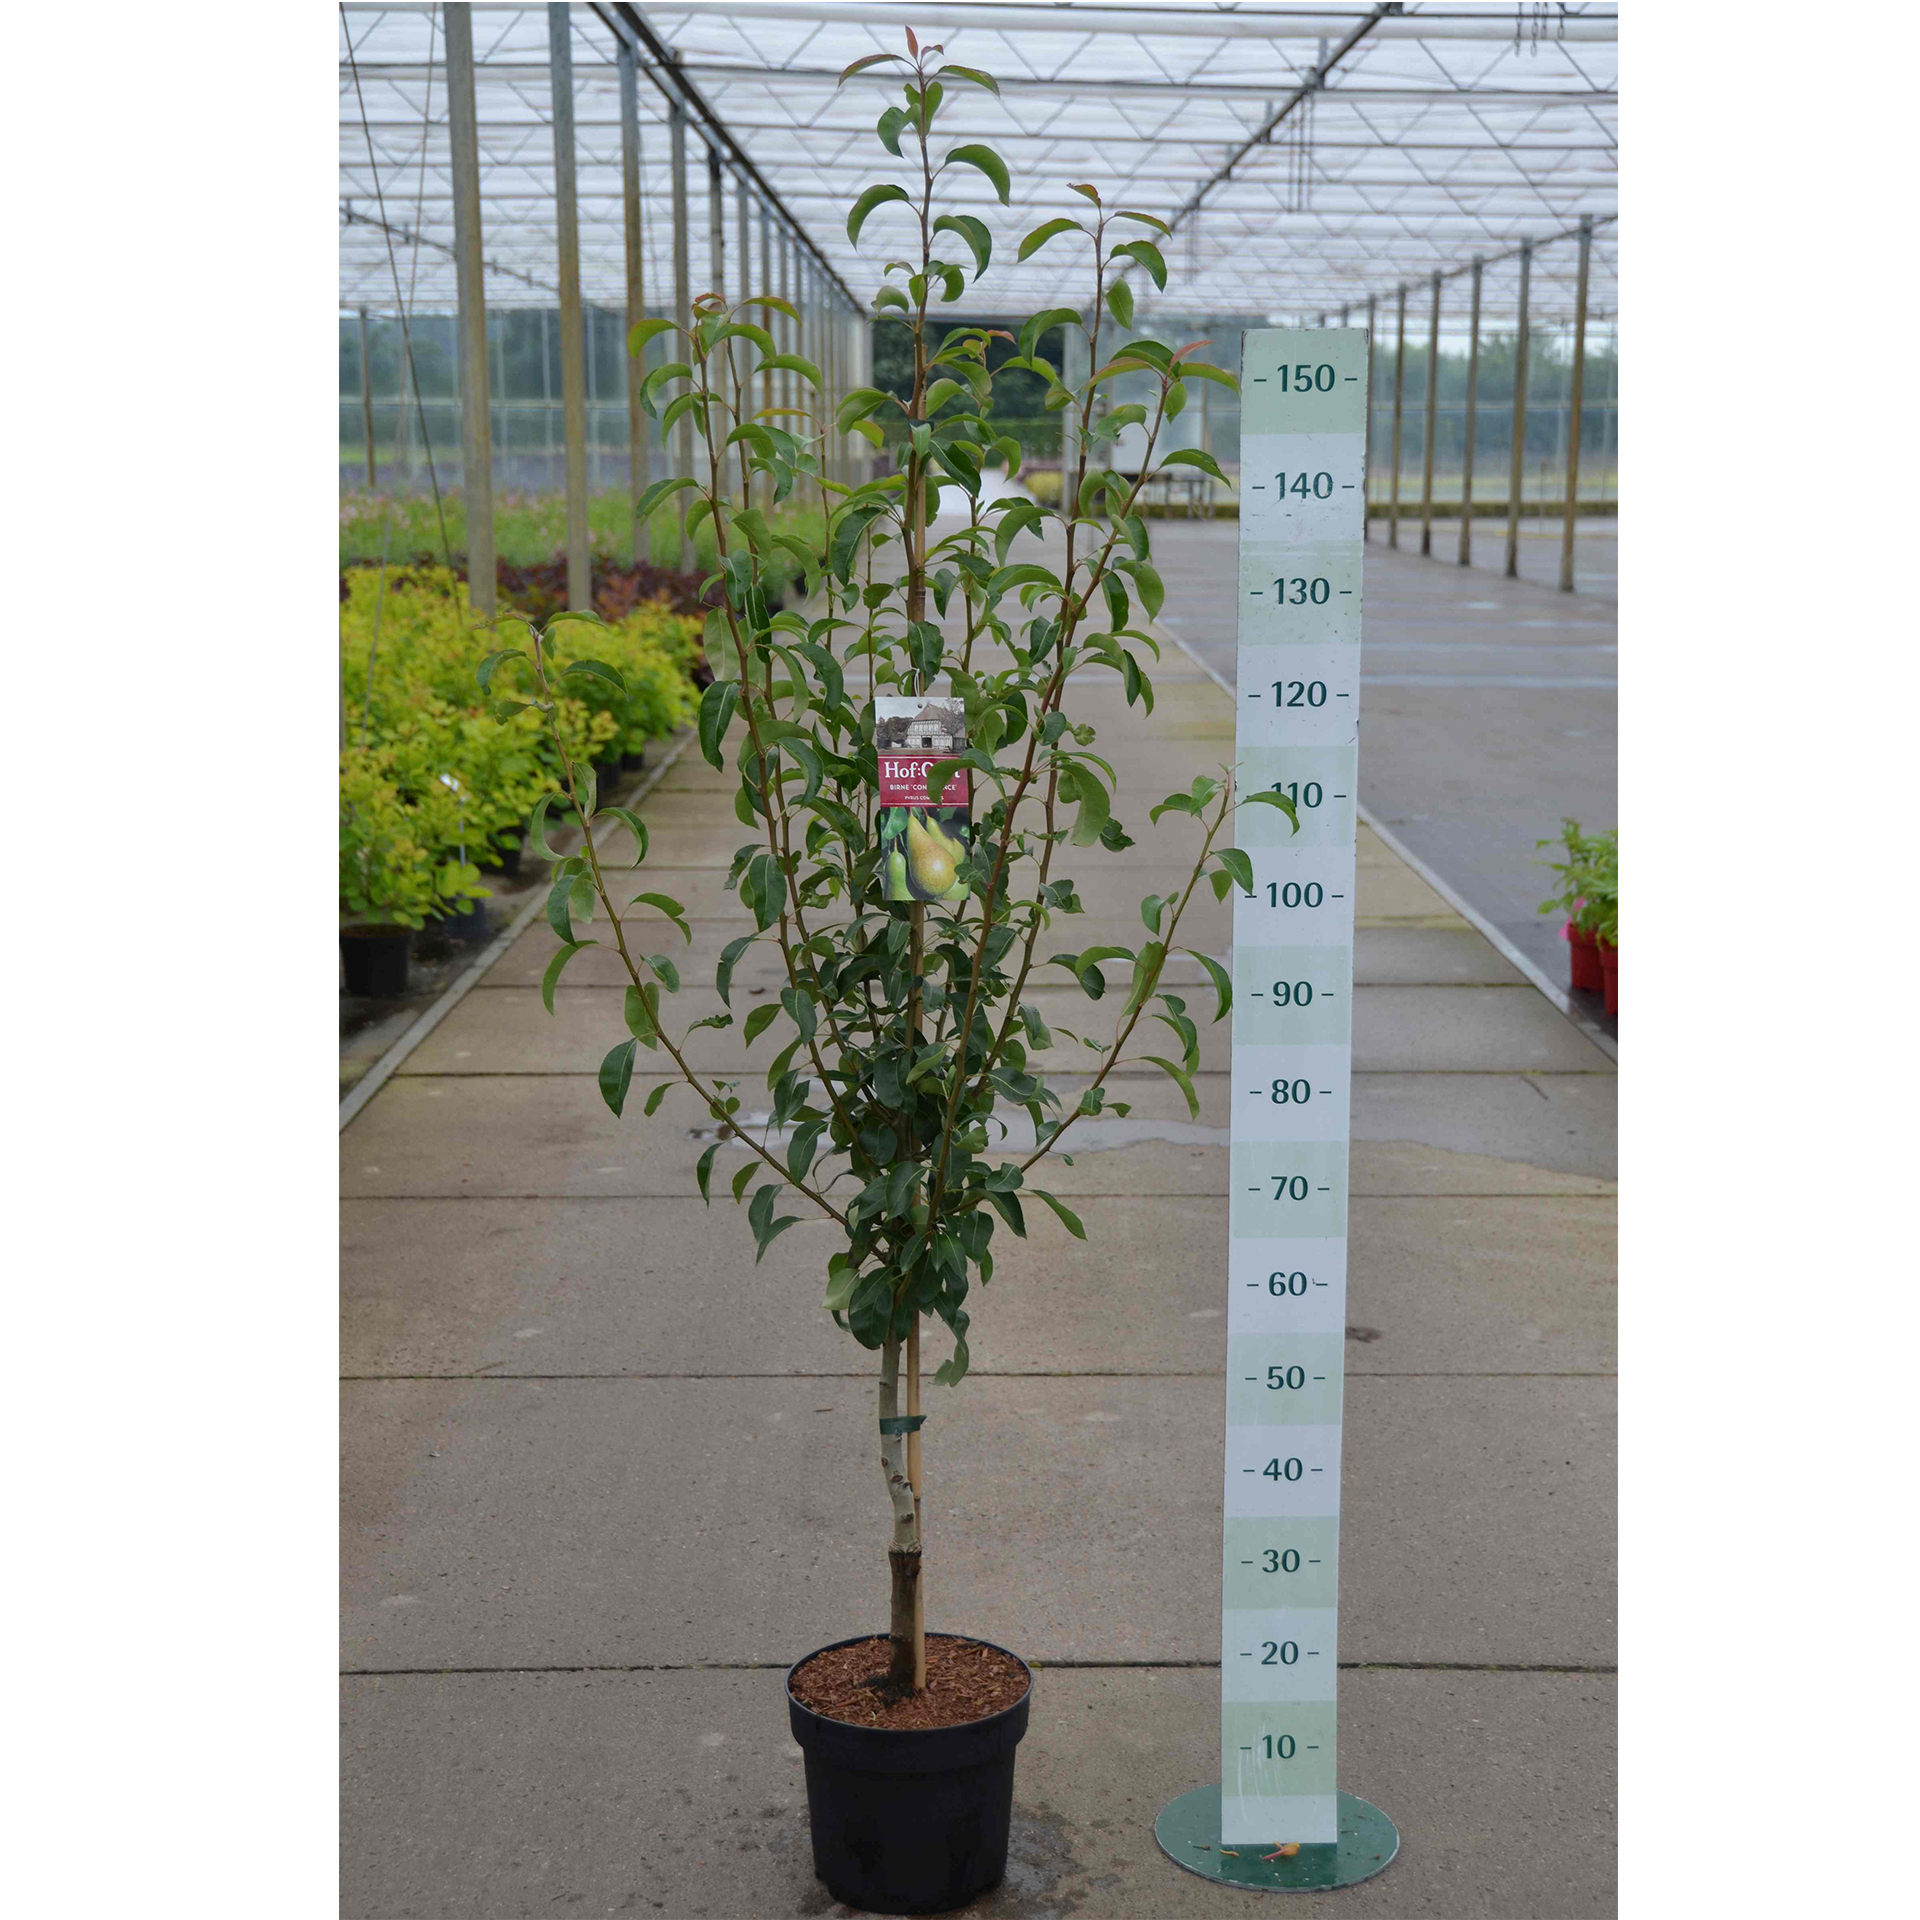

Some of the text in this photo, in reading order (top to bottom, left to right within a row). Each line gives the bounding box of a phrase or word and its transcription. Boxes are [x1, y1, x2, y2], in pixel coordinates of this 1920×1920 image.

[1278, 364, 1335, 393] 150
[1275, 472, 1334, 500] 140
[1273, 578, 1330, 605] 130
[1271, 681, 1327, 708] 120
[1267, 883, 1324, 908] 100
[1272, 982, 1313, 1007] 90
[1271, 1079, 1311, 1105] 80
[1270, 1176, 1309, 1201] 70
[1268, 1271, 1308, 1297] 60
[1266, 1366, 1305, 1390] 50
[1262, 1458, 1303, 1482] 40
[1261, 1549, 1301, 1573] 30
[1261, 1641, 1299, 1665] 20
[1262, 1735, 1296, 1760] 10
